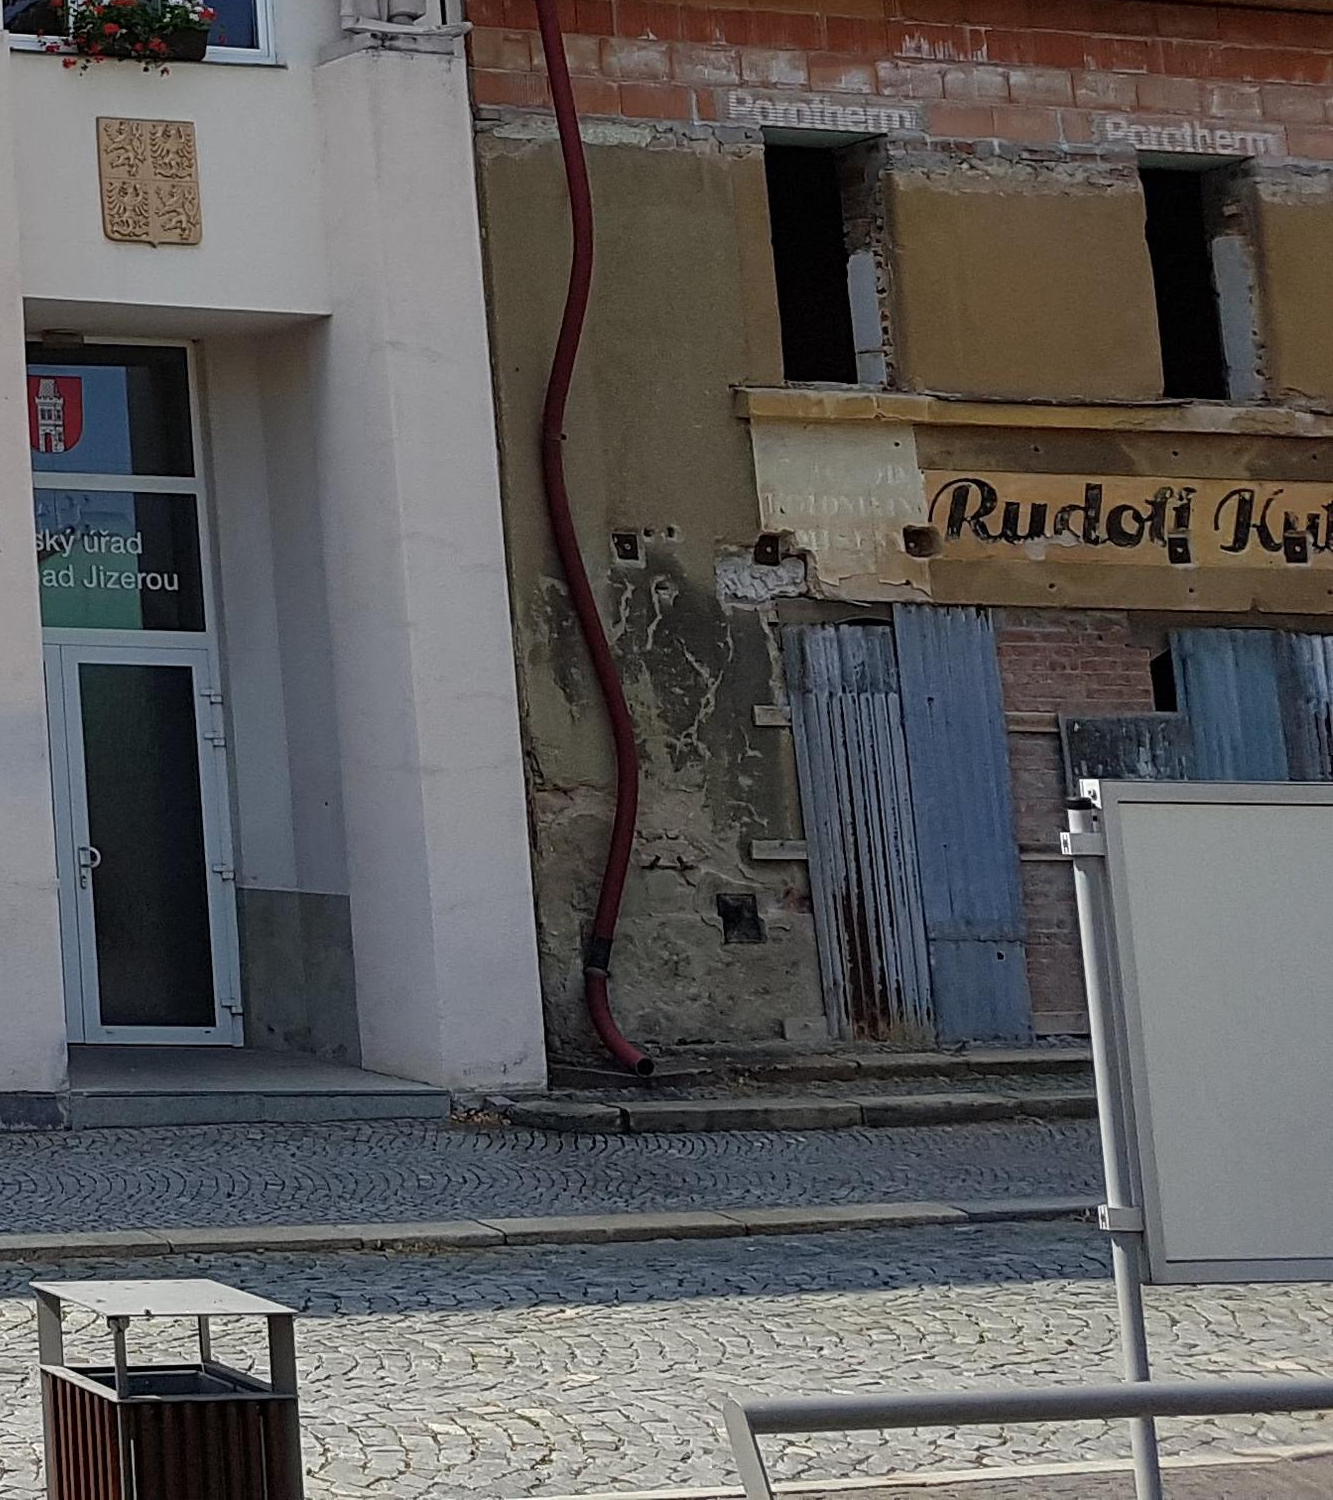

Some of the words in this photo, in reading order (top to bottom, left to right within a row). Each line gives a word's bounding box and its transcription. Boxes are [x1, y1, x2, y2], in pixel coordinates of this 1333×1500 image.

[728, 90, 919, 131] Porotherm
[83, 528, 143, 554] úřad
[83, 565, 179, 591] Jizerou
